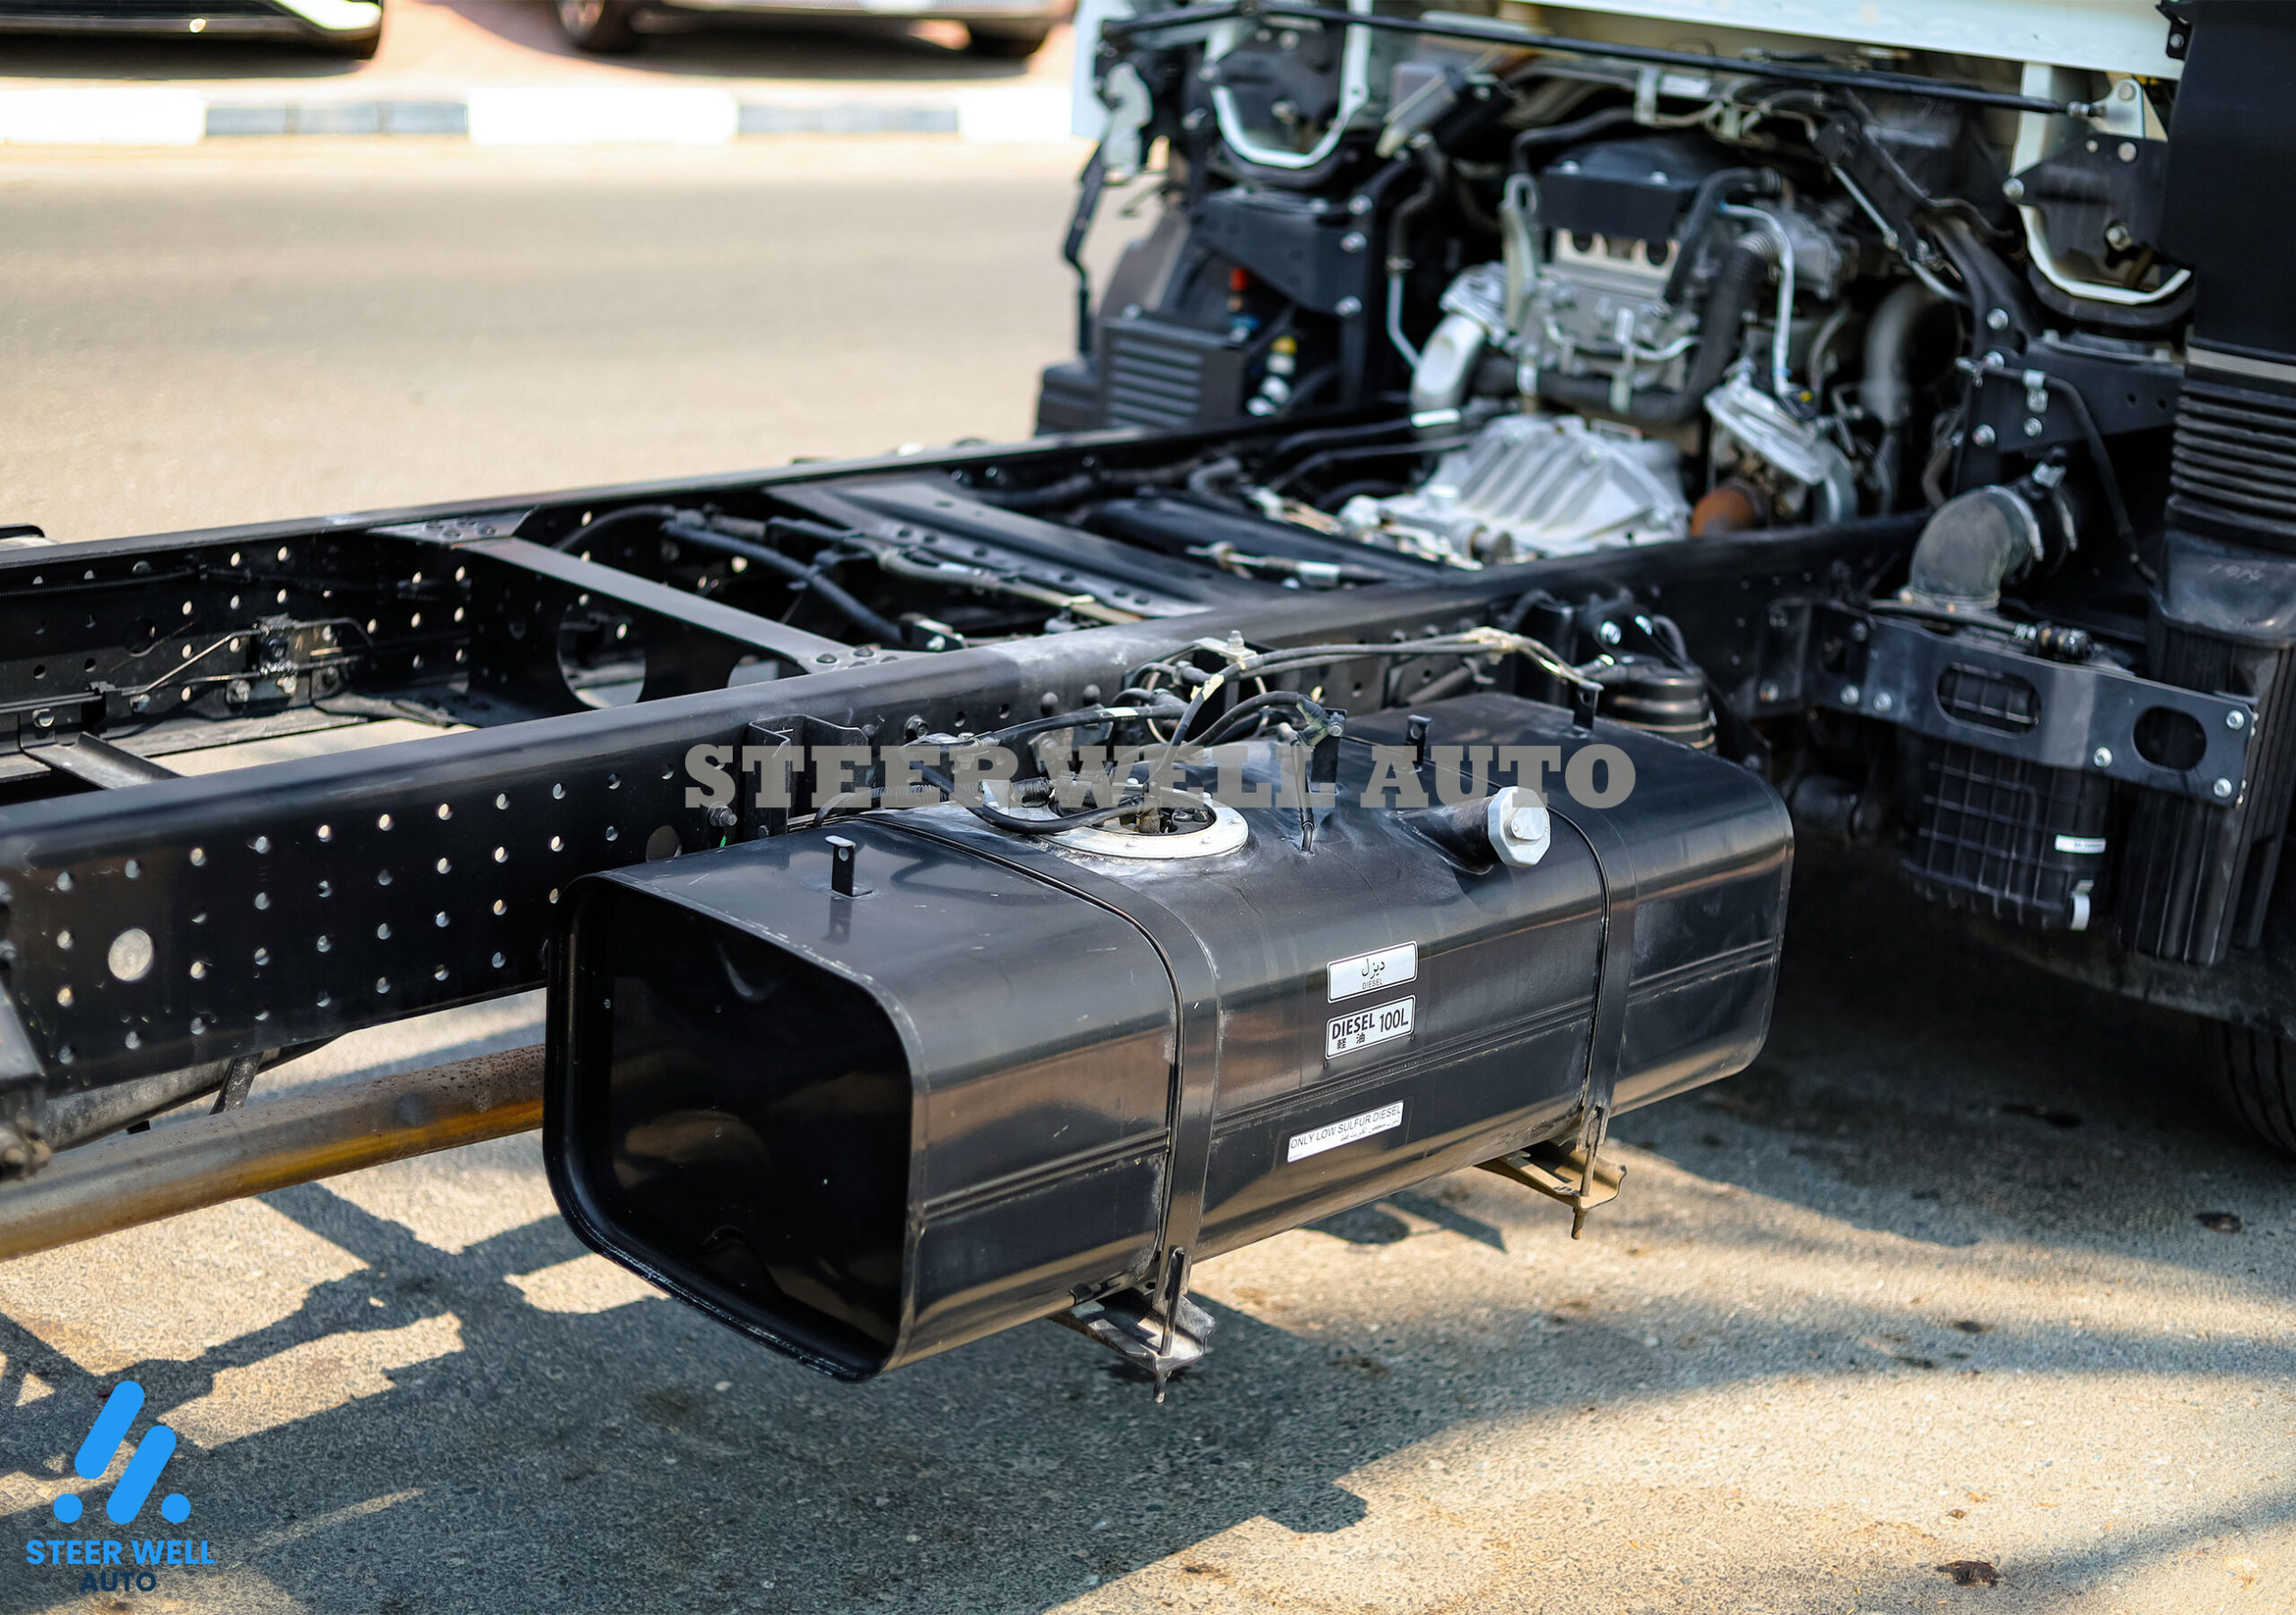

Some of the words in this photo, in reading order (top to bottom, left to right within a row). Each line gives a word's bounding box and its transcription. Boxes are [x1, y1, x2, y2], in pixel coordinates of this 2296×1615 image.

[1361, 958, 1386, 979] ديزل
[1361, 978, 1383, 990] DIESEL
[1332, 1012, 1375, 1040] DIESEL
[1379, 1008, 1409, 1033] 100L
[1290, 1133, 1316, 1149] ONLY
[1316, 1126, 1337, 1142] LOW
[1337, 1115, 1371, 1134] SULFUR
[1372, 1105, 1401, 1123] DIESEL
